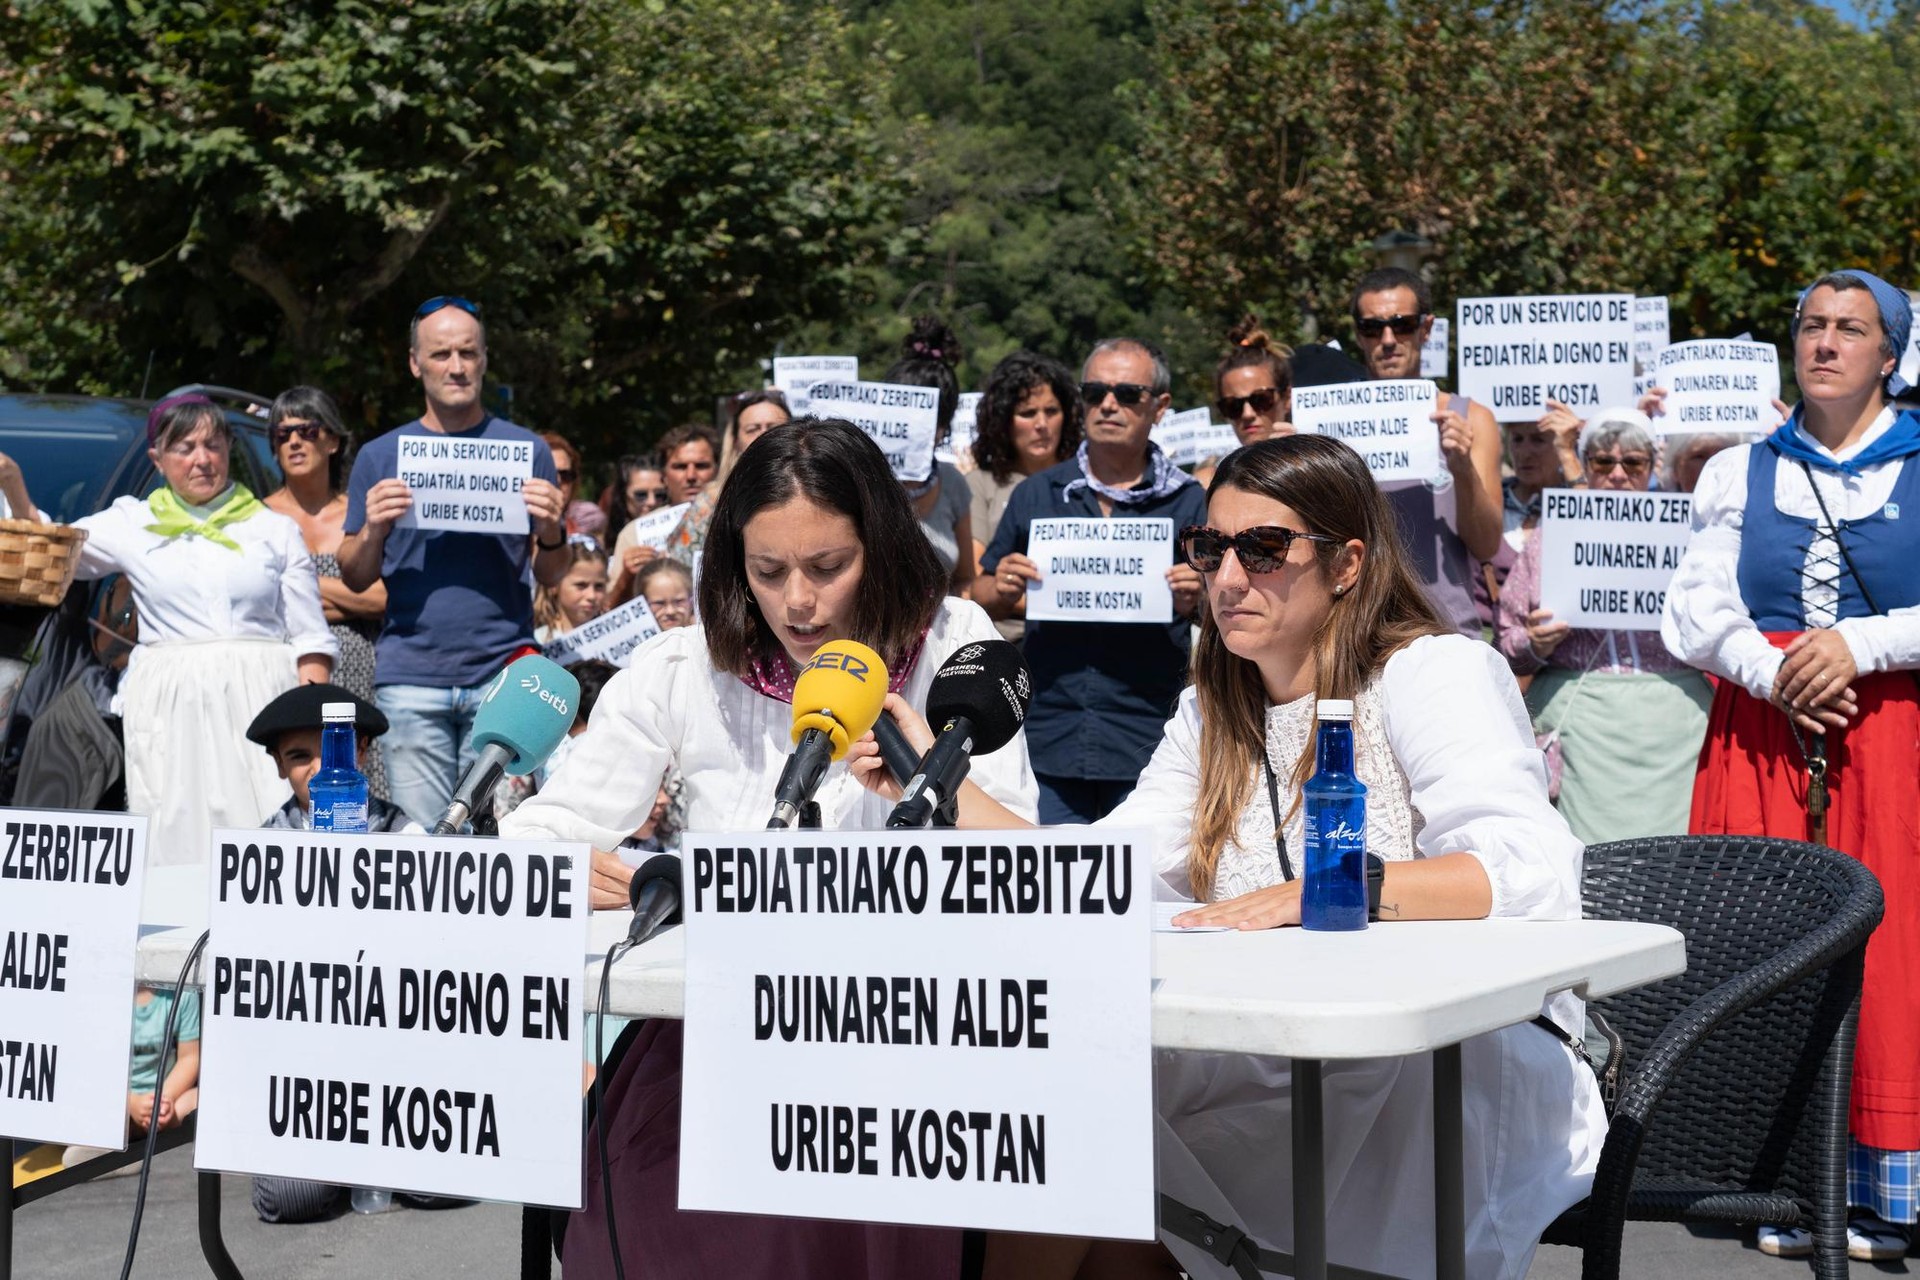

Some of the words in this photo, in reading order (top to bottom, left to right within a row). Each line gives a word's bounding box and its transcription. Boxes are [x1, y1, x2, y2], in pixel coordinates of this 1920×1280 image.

[1462, 304, 1495, 326] POR
[1500, 303, 1523, 325] UN
[1529, 301, 1603, 324] SERVICIO
[1608, 300, 1628, 321] DE
[1463, 338, 1548, 367] PEDIATRÍA
[1553, 342, 1602, 364] DIGNO
[1608, 342, 1628, 364] EN
[1660, 345, 1726, 366] PEDIATRIAKO
[1729, 345, 1774, 363] ZERBITZU
[1297, 386, 1371, 409] PEDIATRIAKO
[1375, 384, 1432, 403] ZERBITZU
[1493, 385, 1541, 407] URIBE
[1547, 383, 1599, 405] KOSTA
[1675, 375, 1729, 392] DUINAREN
[1733, 376, 1758, 391] ALDE
[810, 384, 878, 405] PEDIATRIAKO
[882, 389, 934, 410] ZERBITZU
[1680, 406, 1711, 422] URIBE
[1716, 406, 1759, 421] KOSTAN
[882, 421, 909, 439] ALDE
[1317, 419, 1376, 438] DUINAREN
[1379, 417, 1409, 435] ALDE
[403, 441, 427, 457] POR
[431, 442, 449, 458] UN
[453, 443, 509, 461] SERVICIO
[513, 446, 529, 462] DE
[470, 475, 508, 492] DIGNO
[422, 503, 459, 520] URIBE
[463, 505, 504, 522] KOSTA
[1547, 495, 1654, 522] PEDIATRIAKO
[1034, 523, 1109, 541] PEDIATRIAKO
[1112, 523, 1169, 541] ZERBITZU
[1052, 557, 1110, 575] DUINAREN
[1114, 557, 1143, 575] ALDE
[1574, 542, 1656, 569] DUINAREN
[1662, 546, 1686, 570] AL
[1056, 590, 1091, 609] URIBE
[1095, 591, 1142, 609] KOSTAN
[1580, 589, 1628, 613] URIBE
[1634, 591, 1665, 615] KOS
[566, 634, 583, 651] UN
[584, 609, 631, 643] SERVICIO
[631, 602, 647, 618] DE
[801, 652, 869, 683] SER
[937, 664, 985, 677] ATRESMEDIA
[2, 822, 134, 886] ZERBITZU
[219, 843, 284, 905] POR
[295, 846, 341, 908] UN
[351, 847, 514, 917] SERVICIO
[526, 854, 573, 918] DE
[693, 845, 929, 915] PEDIATRIAKO
[940, 844, 1132, 916] ZERBITZU
[0, 931, 68, 992] ALDE
[213, 949, 387, 1029] PEDIATRÍA
[398, 967, 510, 1037] DIGNO
[522, 975, 569, 1041] EN
[754, 974, 938, 1046] DUINAREN
[951, 978, 1049, 1049] ALDE
[268, 1075, 370, 1145] URIBE
[381, 1084, 500, 1158] KOSTA
[770, 1103, 878, 1176] URIBE
[891, 1108, 1046, 1185] KOSTAN
